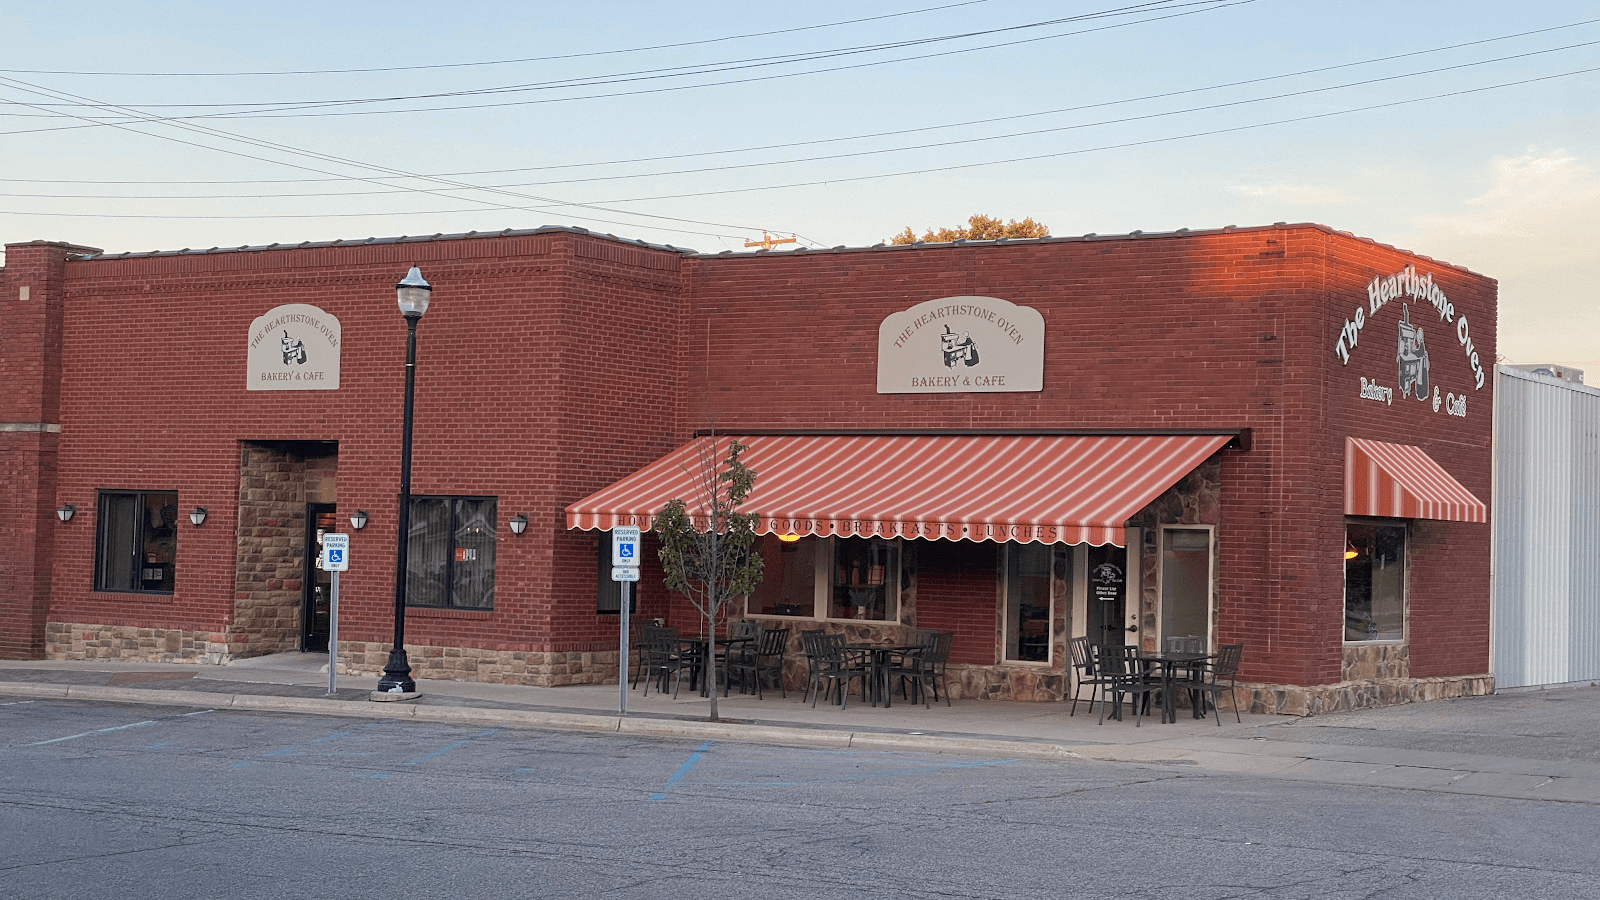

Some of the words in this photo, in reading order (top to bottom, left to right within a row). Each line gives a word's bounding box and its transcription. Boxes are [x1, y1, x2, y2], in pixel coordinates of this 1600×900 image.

[250, 330, 265, 349] THE
[264, 313, 321, 334] HEARTHSTONE
[320, 325, 339, 348] OVEN
[893, 326, 914, 349] THE
[913, 305, 997, 330] HEARTHSTONE
[997, 317, 1024, 345] OVEN
[1335, 306, 1365, 366] The
[1367, 264, 1455, 323] Hearthstone
[1457, 314, 1485, 391] Oven
[261, 370, 295, 381] BAKERY
[295, 371, 301, 381] &
[303, 371, 325, 381] CAFE
[911, 374, 960, 387] BAKERY
[962, 376, 971, 386] &
[975, 375, 1006, 386] CAFE
[1360, 376, 1393, 406] Bakery
[770, 519, 823, 532] GOODS
[842, 520, 955, 536] BREAKFASTS
[975, 524, 1058, 538] LUNCHES
